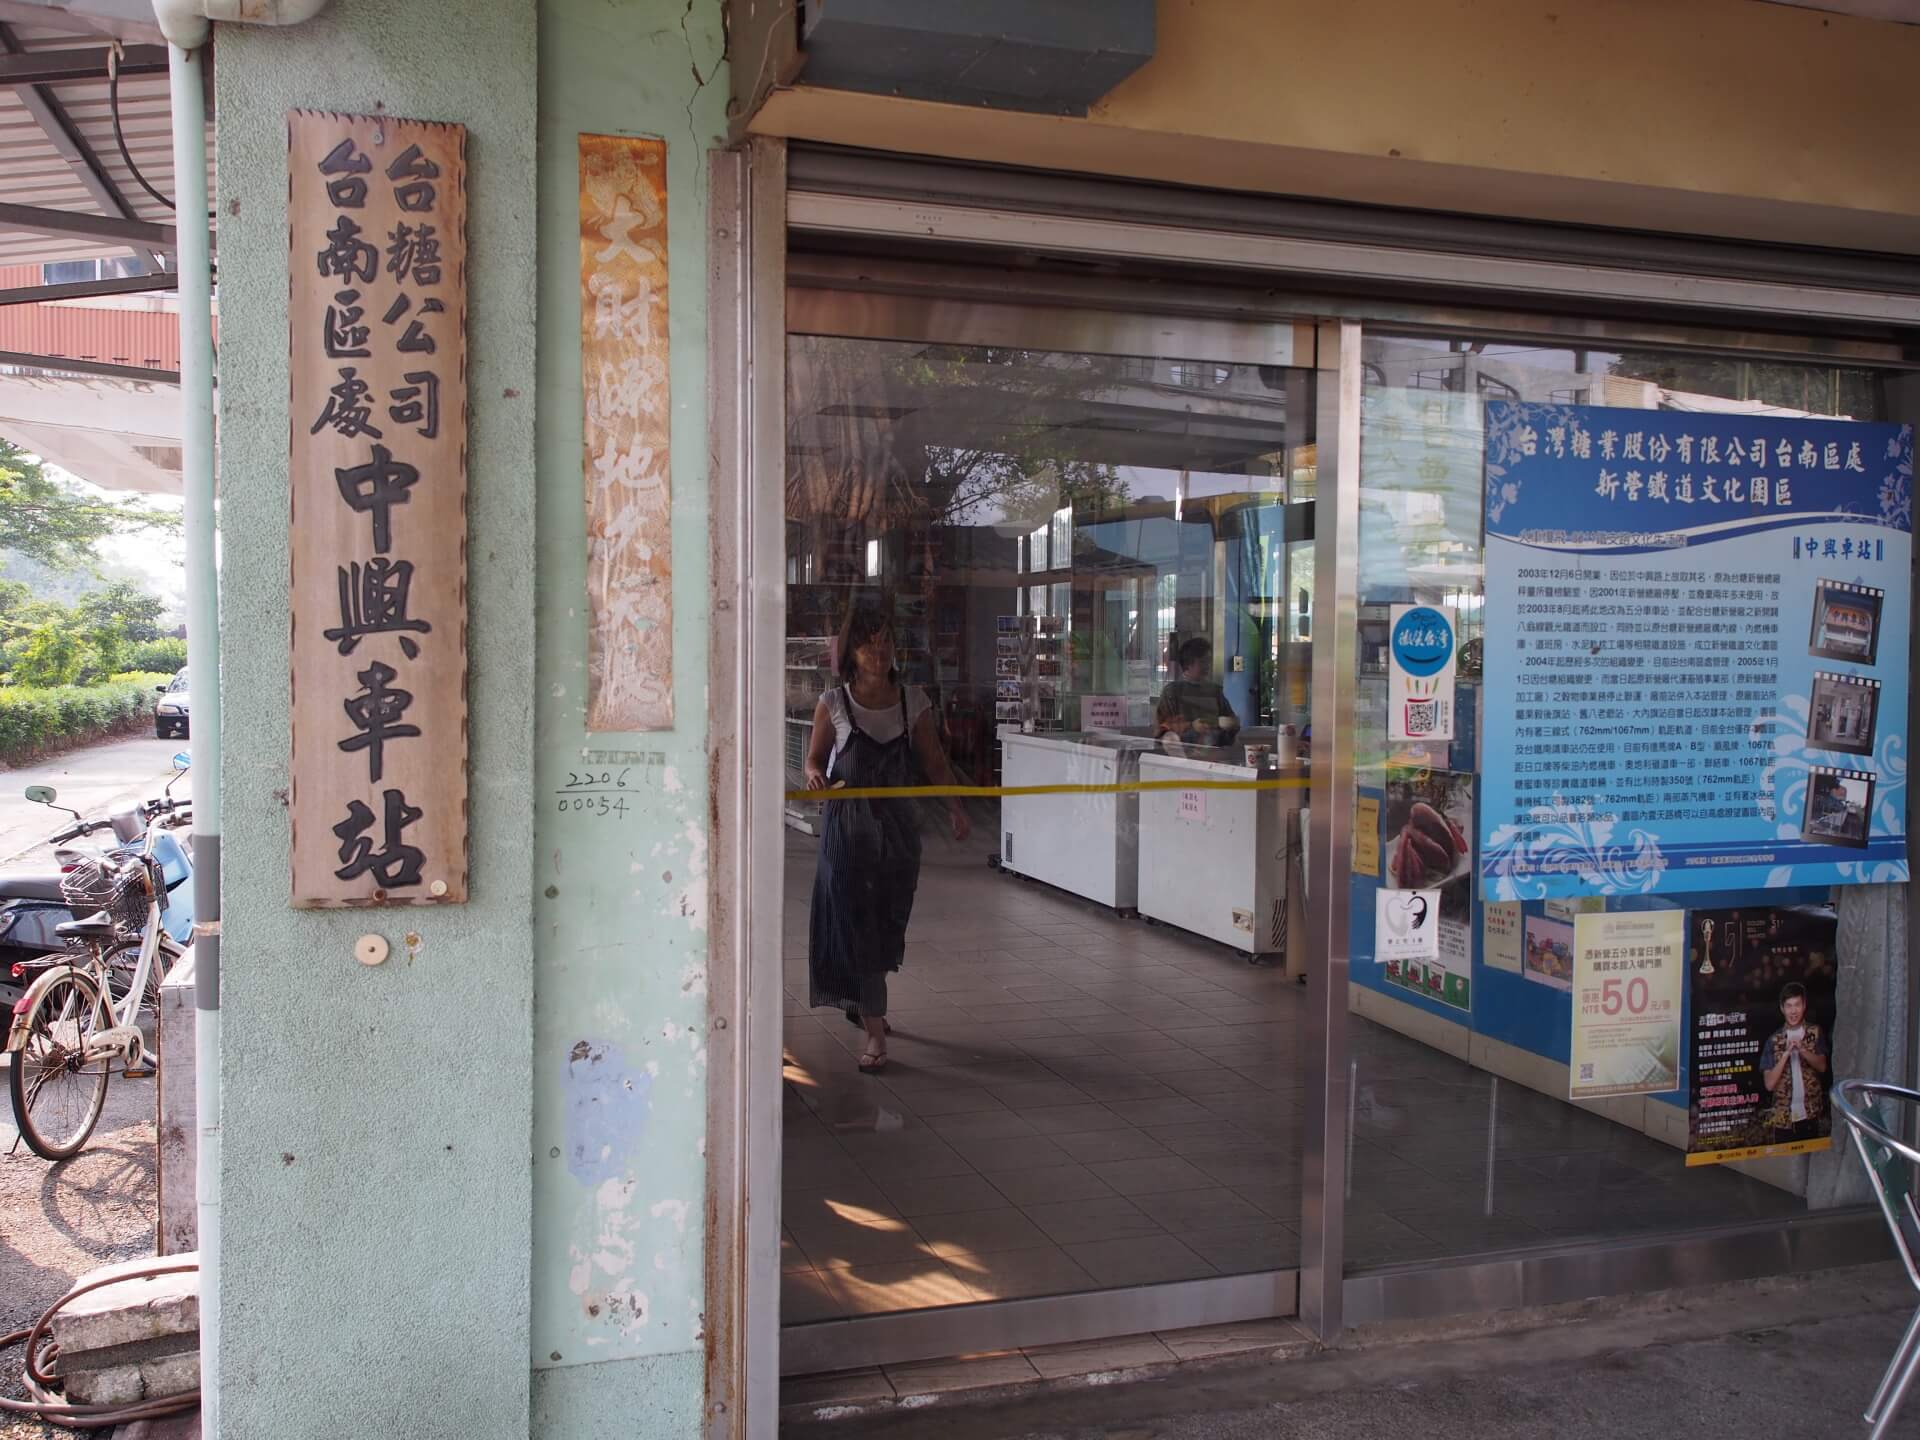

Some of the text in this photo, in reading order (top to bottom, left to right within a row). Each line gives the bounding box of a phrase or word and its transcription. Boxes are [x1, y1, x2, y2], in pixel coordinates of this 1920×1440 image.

[310, 137, 383, 440] 台南區處
[382, 143, 446, 440] 台糖公司
[1518, 425, 1865, 473] 台灣糖業股份有限公司台南區處
[1594, 467, 1793, 506] 新營鐵道文化園區
[1805, 536, 1871, 560] 中興車站
[323, 444, 432, 888] 中興車站
[566, 768, 631, 788] 2206
[558, 797, 631, 819] 00054
[1601, 976, 1650, 1017] 50
